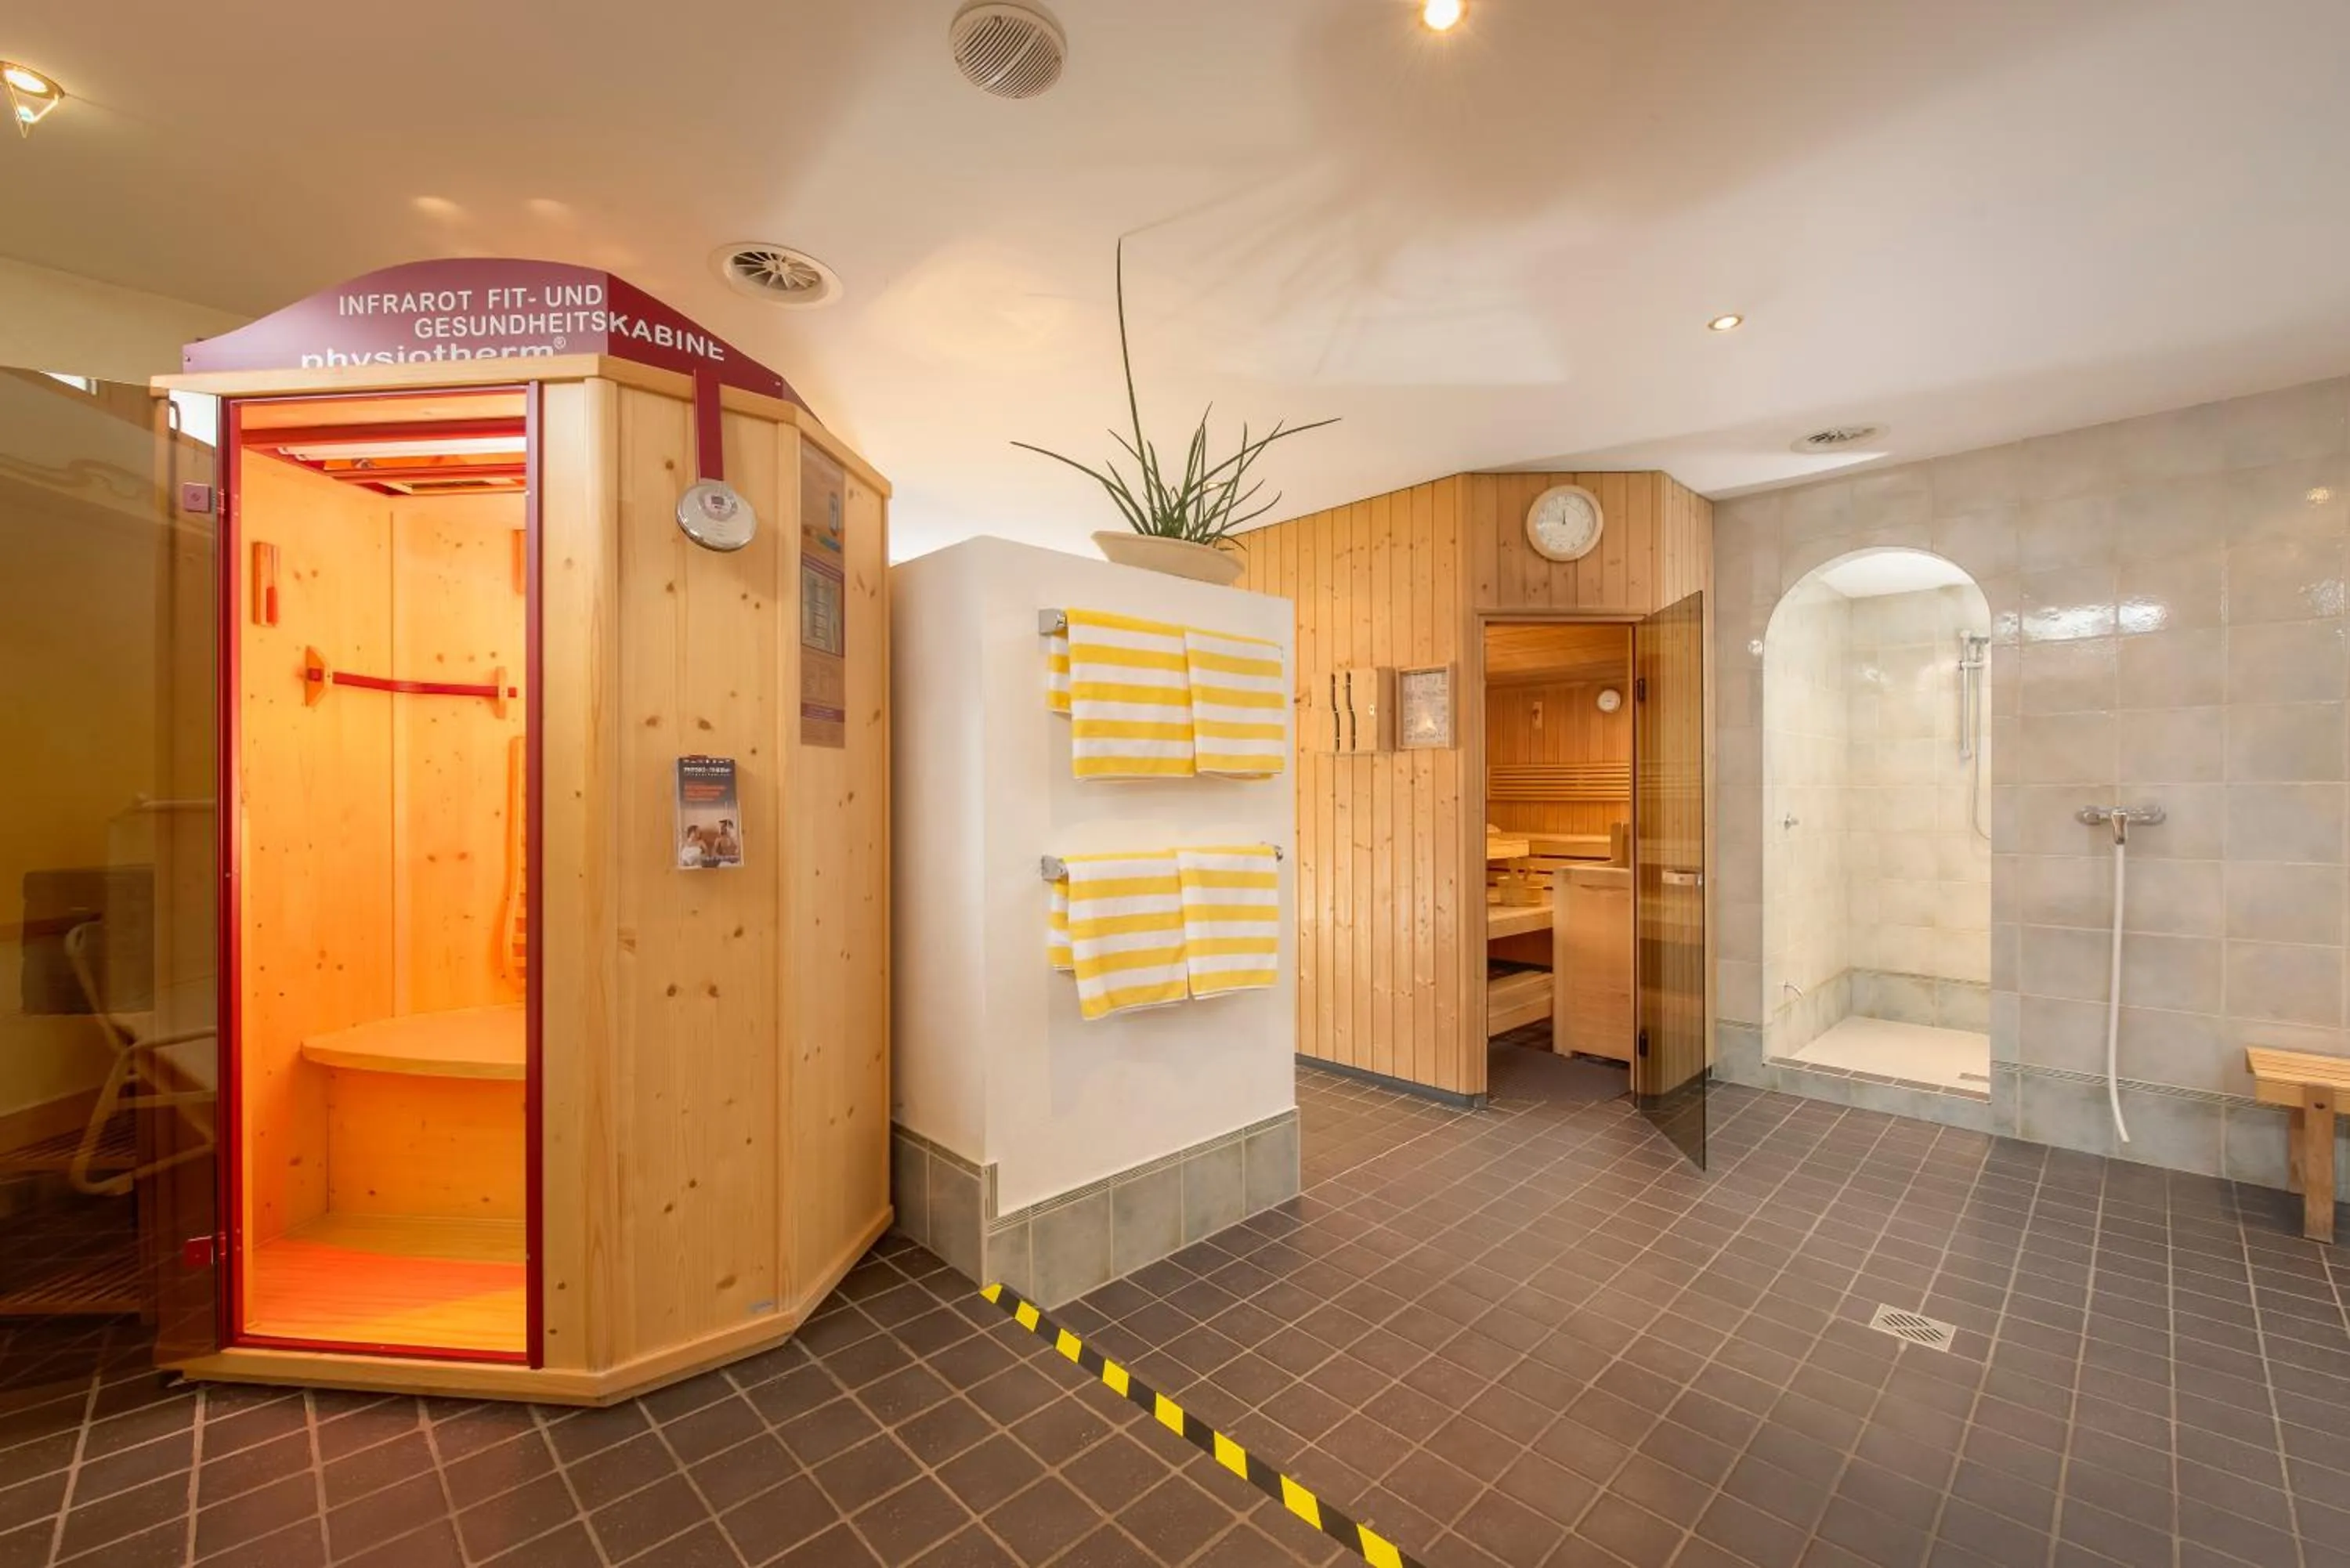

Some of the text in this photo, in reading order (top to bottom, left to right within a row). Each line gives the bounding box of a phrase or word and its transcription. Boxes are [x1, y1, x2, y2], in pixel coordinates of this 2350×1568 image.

[339, 284, 603, 315] INFRAROT FIT- UND
